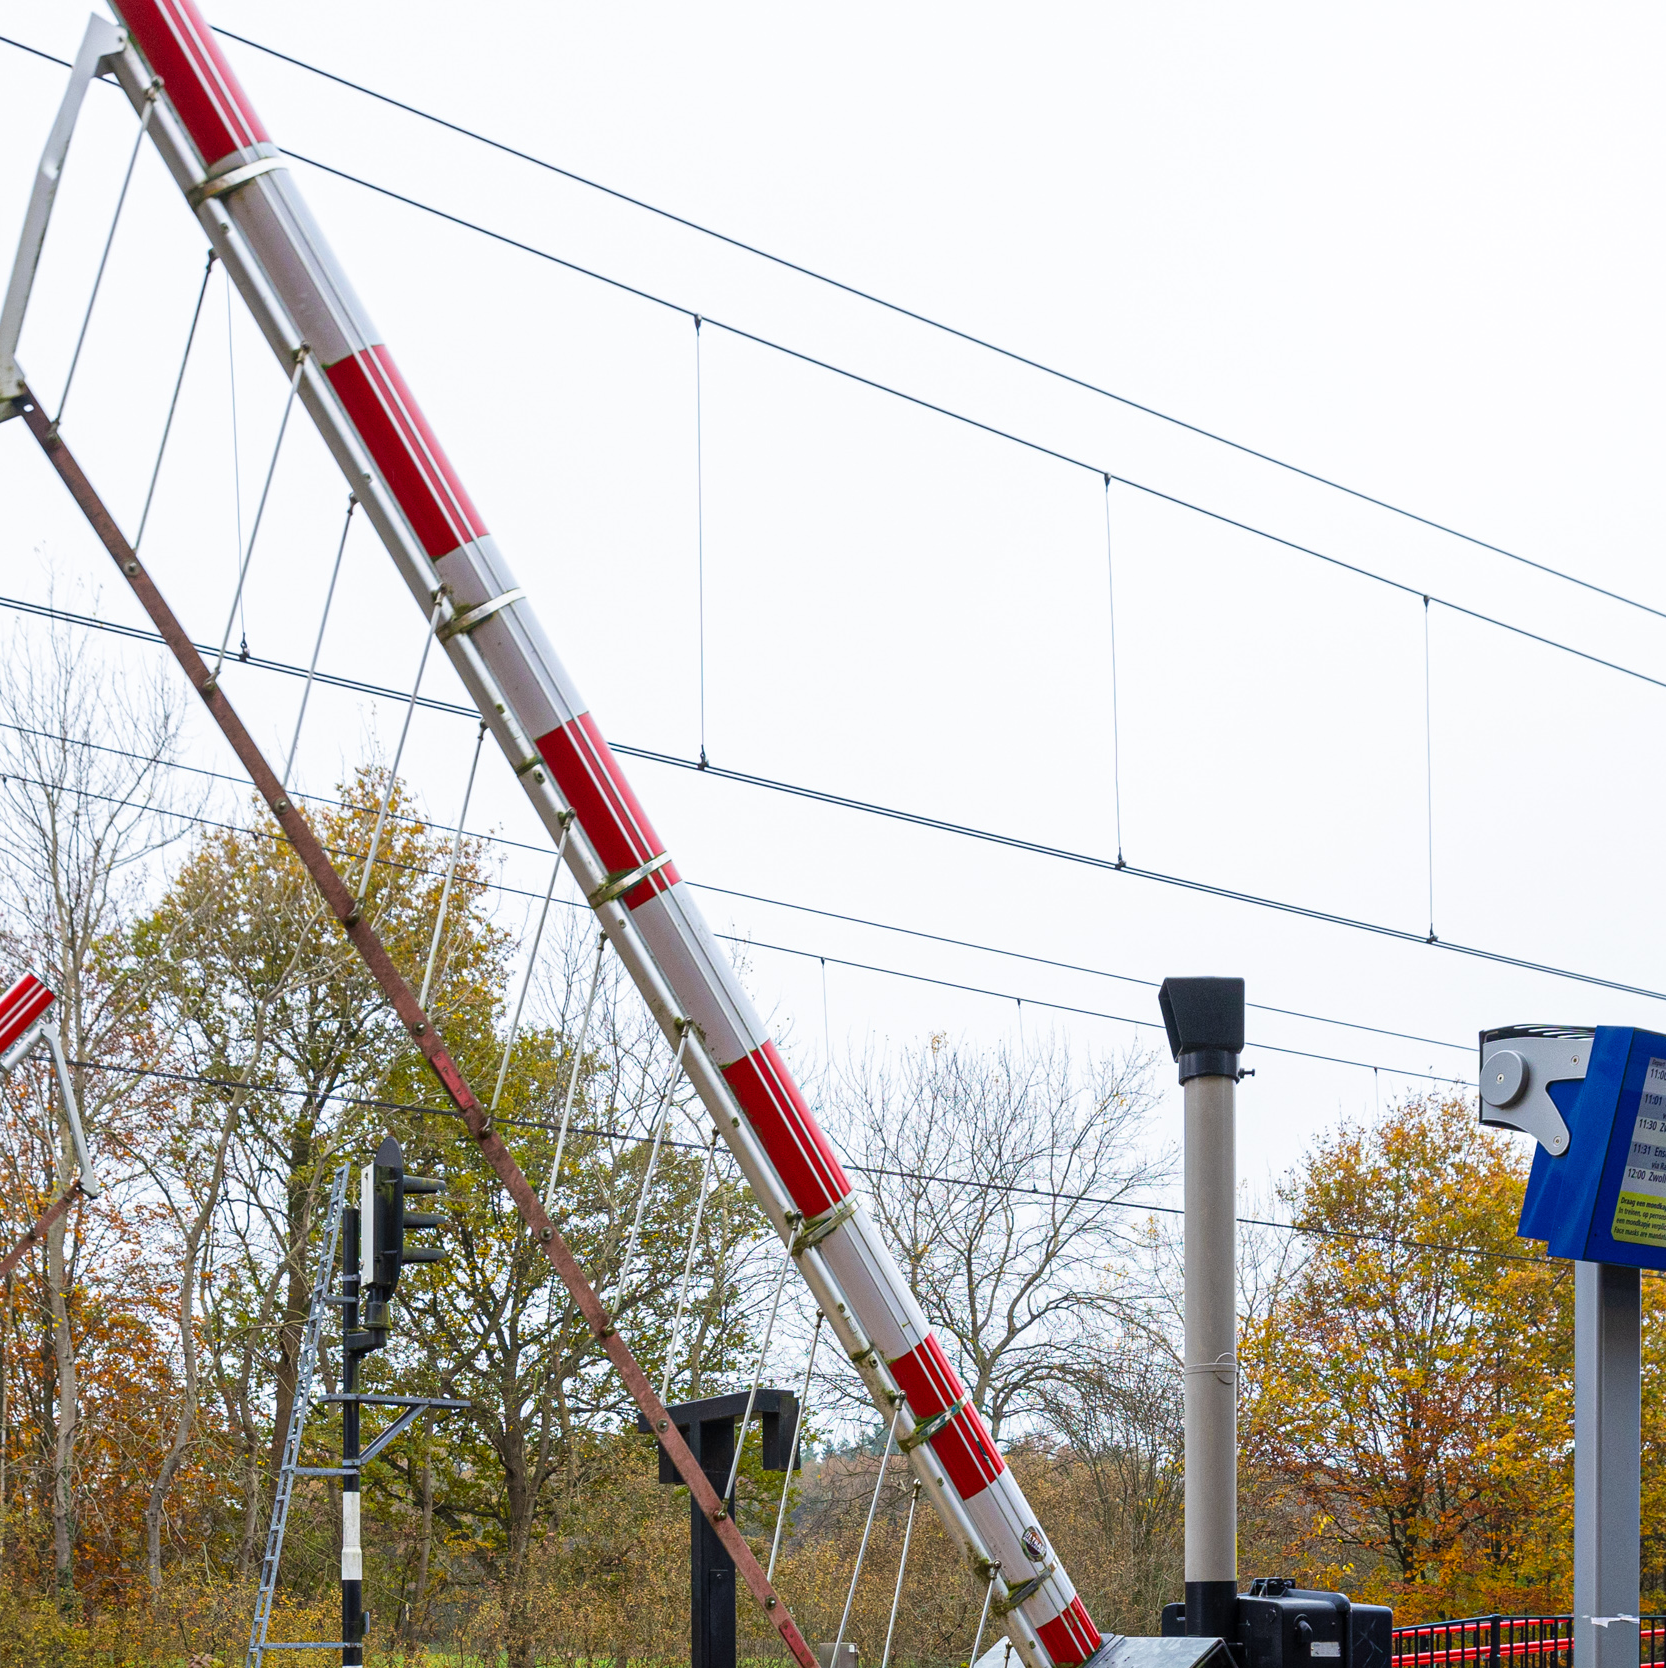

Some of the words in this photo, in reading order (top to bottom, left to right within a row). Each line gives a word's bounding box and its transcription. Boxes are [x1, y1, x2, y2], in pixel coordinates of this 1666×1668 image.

[1644, 1094, 1663, 1106] 11:01
[1639, 1118, 1658, 1131] 11:30
[1633, 1143, 1651, 1155] 11:31
[1651, 1160, 1660, 1169] via
[1627, 1168, 1646, 1180] 12:00
[1621, 1196, 1635, 1207] Draag
[1649, 1212, 1666, 1220] perrons
[1625, 1218, 1650, 1230] mondkapje
[1625, 1228, 1640, 1236] masks
